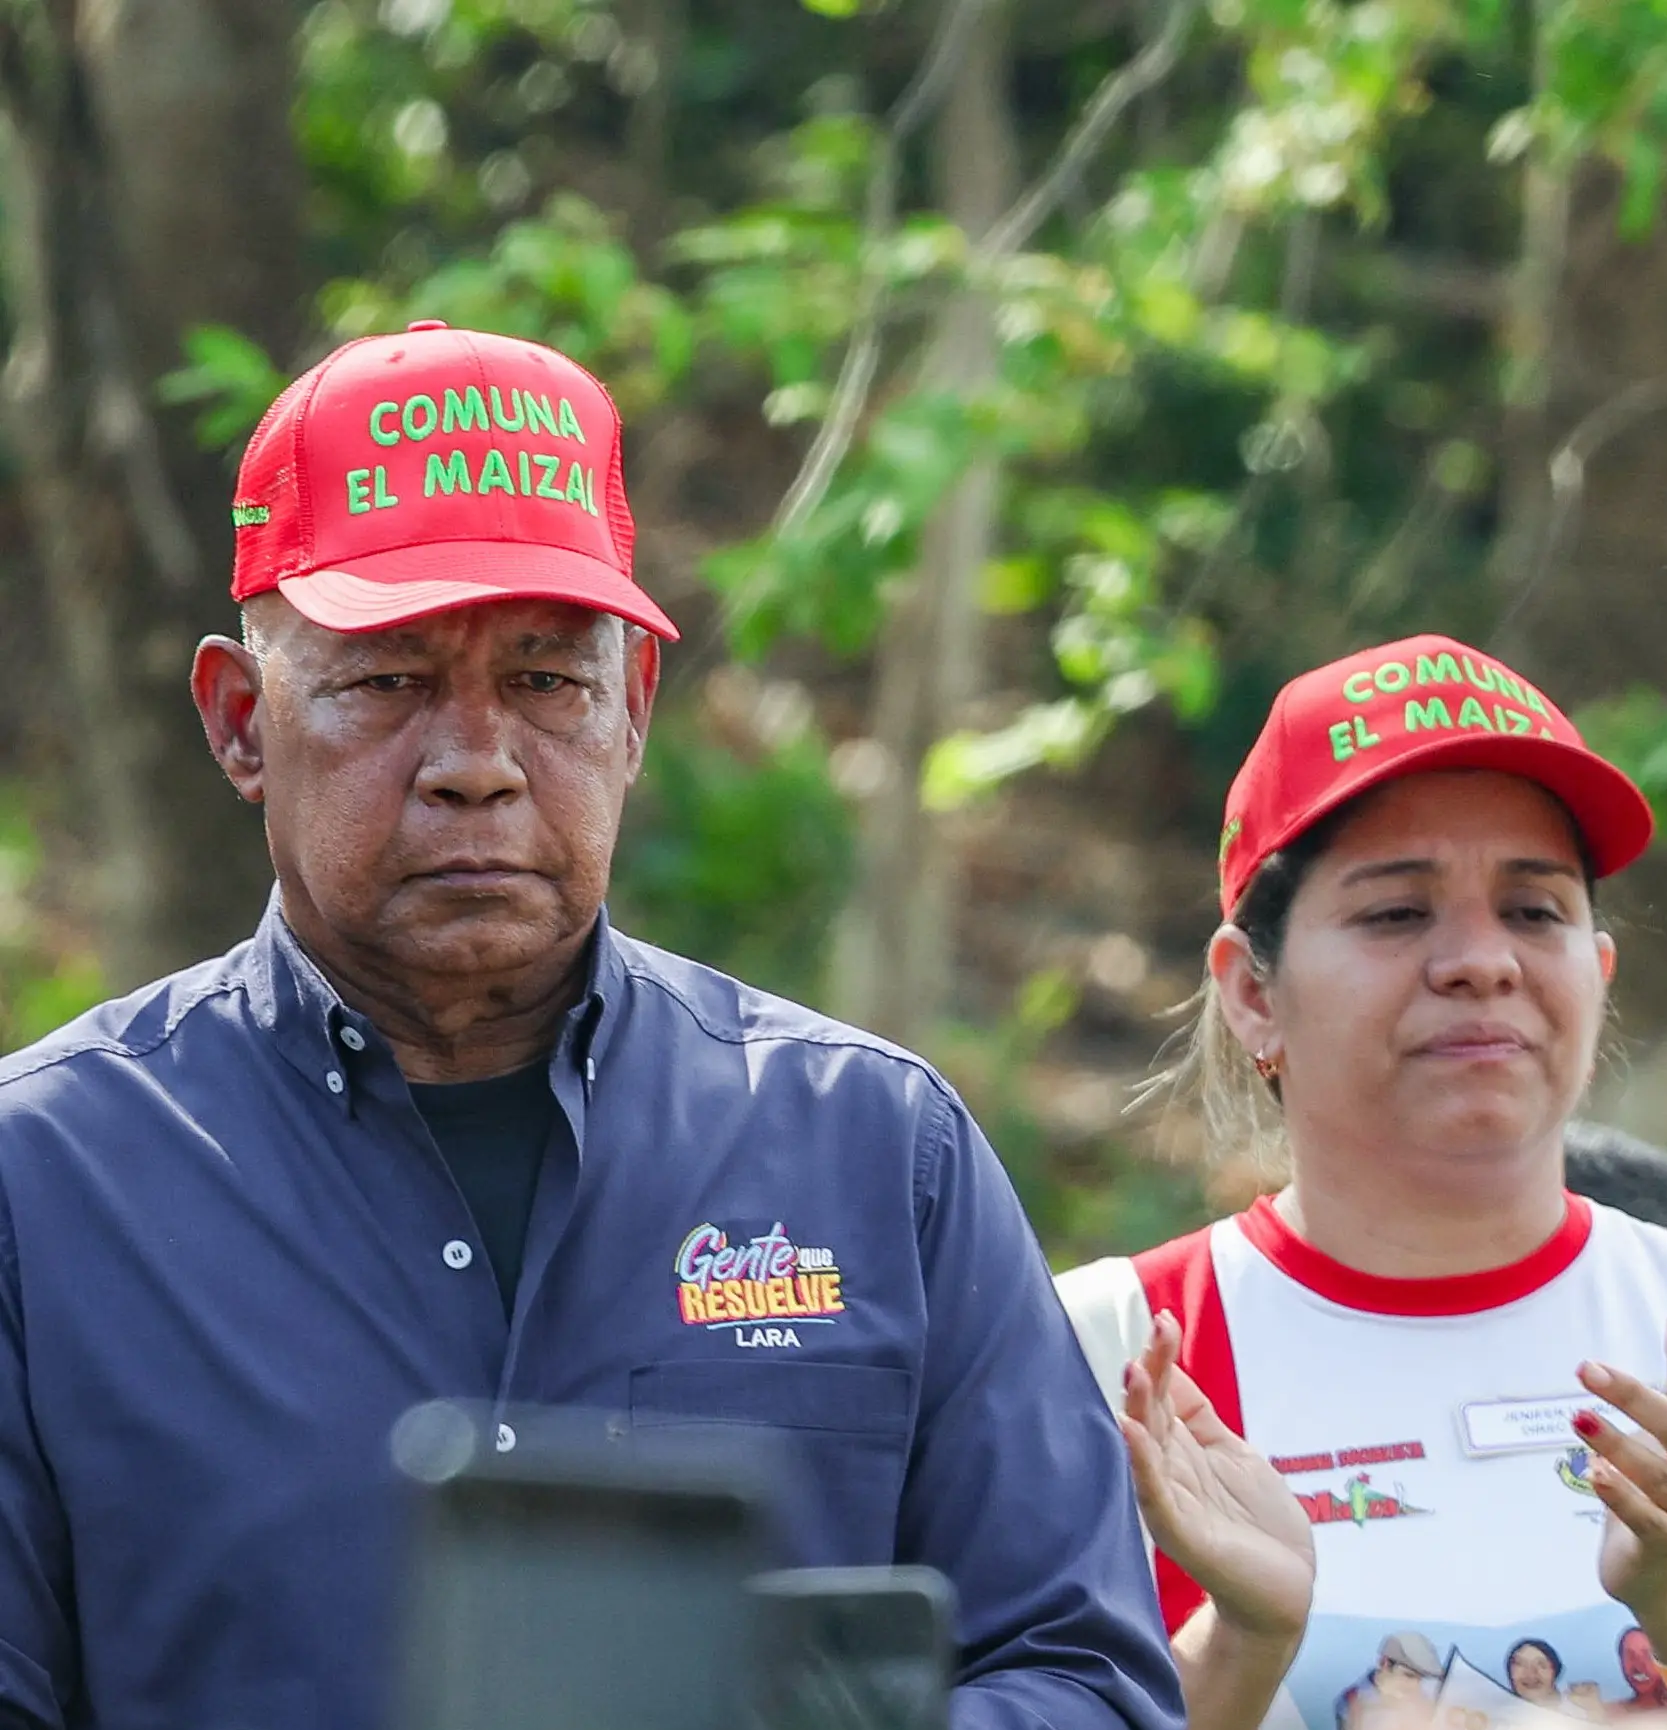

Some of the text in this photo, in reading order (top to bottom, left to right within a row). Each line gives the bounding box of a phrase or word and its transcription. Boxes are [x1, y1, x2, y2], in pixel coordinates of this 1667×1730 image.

[370, 386, 586, 446] COMUNA
[346, 449, 598, 517] EL MAIZAL
[1343, 653, 1553, 722] COMUNA
[1328, 697, 1555, 761] EL MAIZ
[675, 1222, 834, 1290] Gente que
[677, 1273, 845, 1324] RESUELVE
[736, 1328, 801, 1347] LARA
